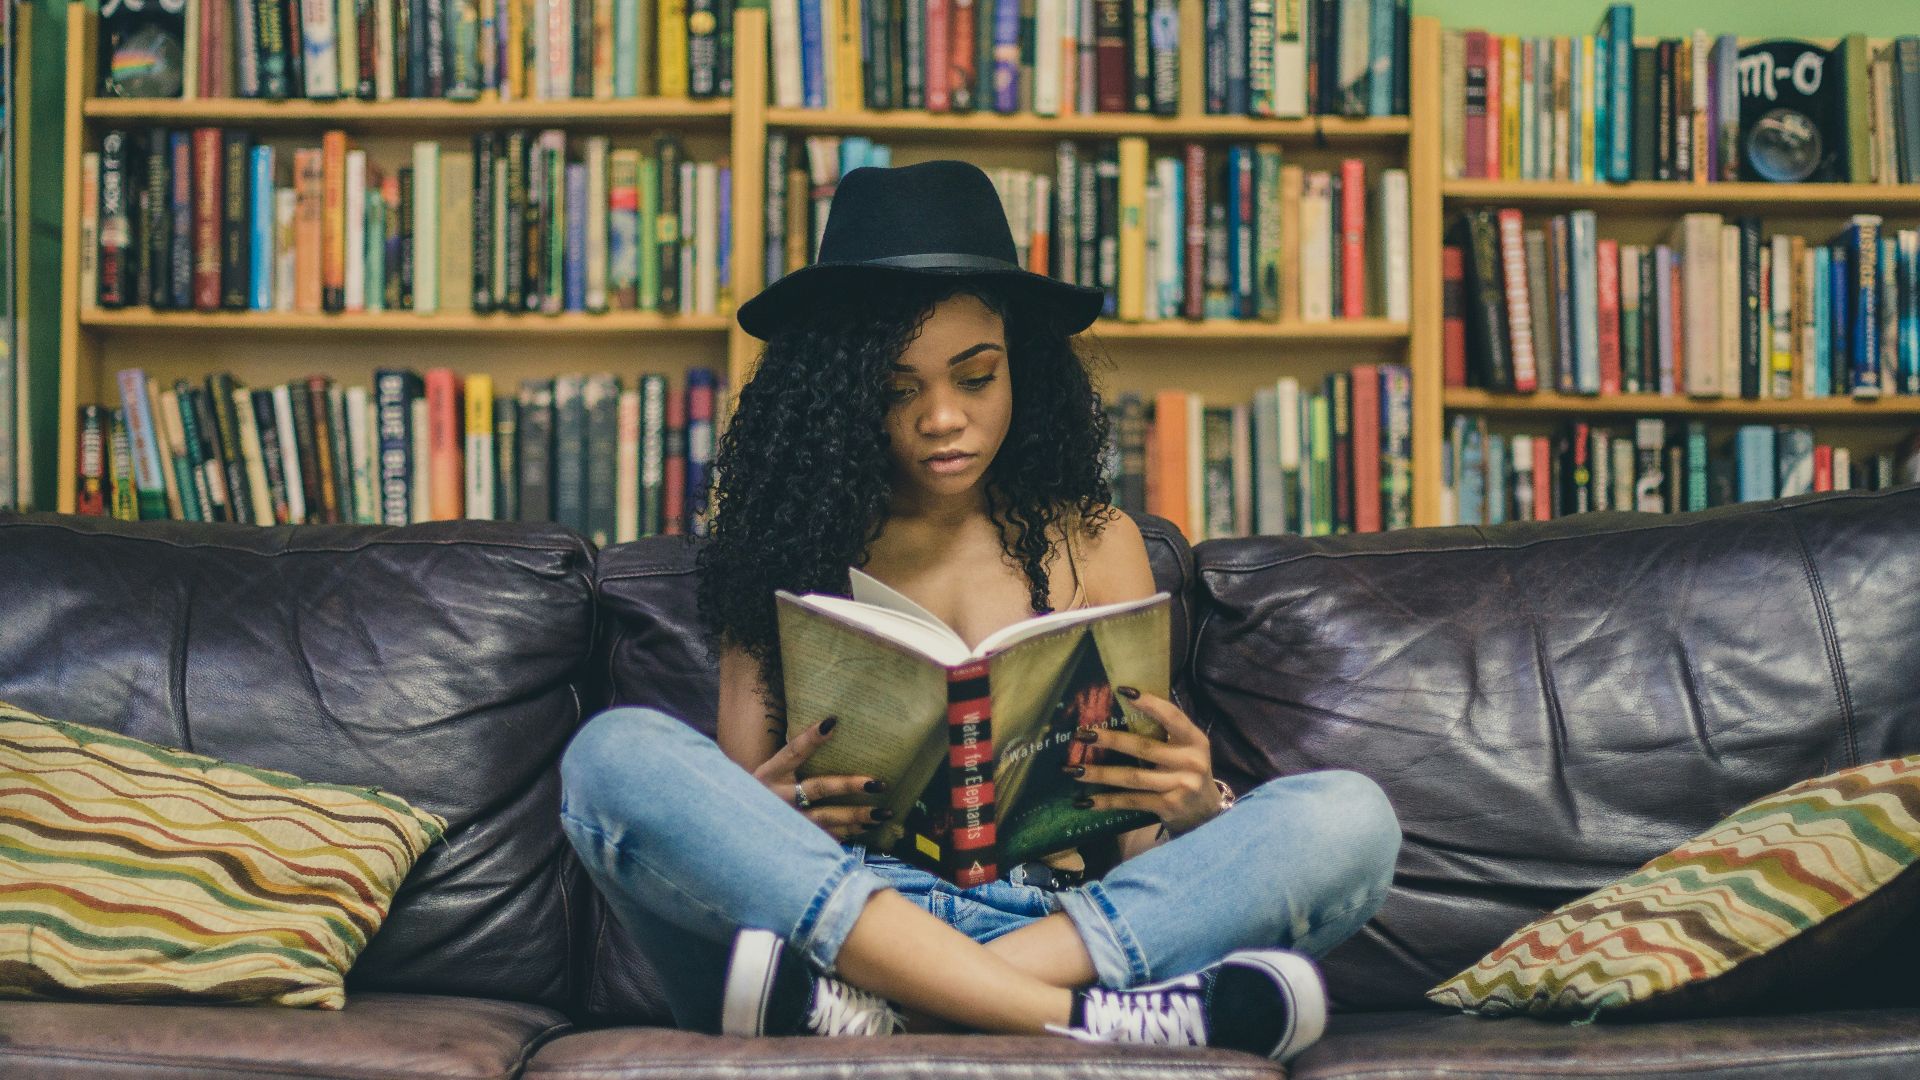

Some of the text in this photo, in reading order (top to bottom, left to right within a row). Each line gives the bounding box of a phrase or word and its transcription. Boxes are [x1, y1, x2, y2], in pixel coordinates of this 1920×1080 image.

[380, 375, 405, 440] BLUE
[1010, 711, 1145, 763] Water for lephant
[962, 711, 984, 840] Water for Elephants
[1066, 822, 1100, 837] SARA
